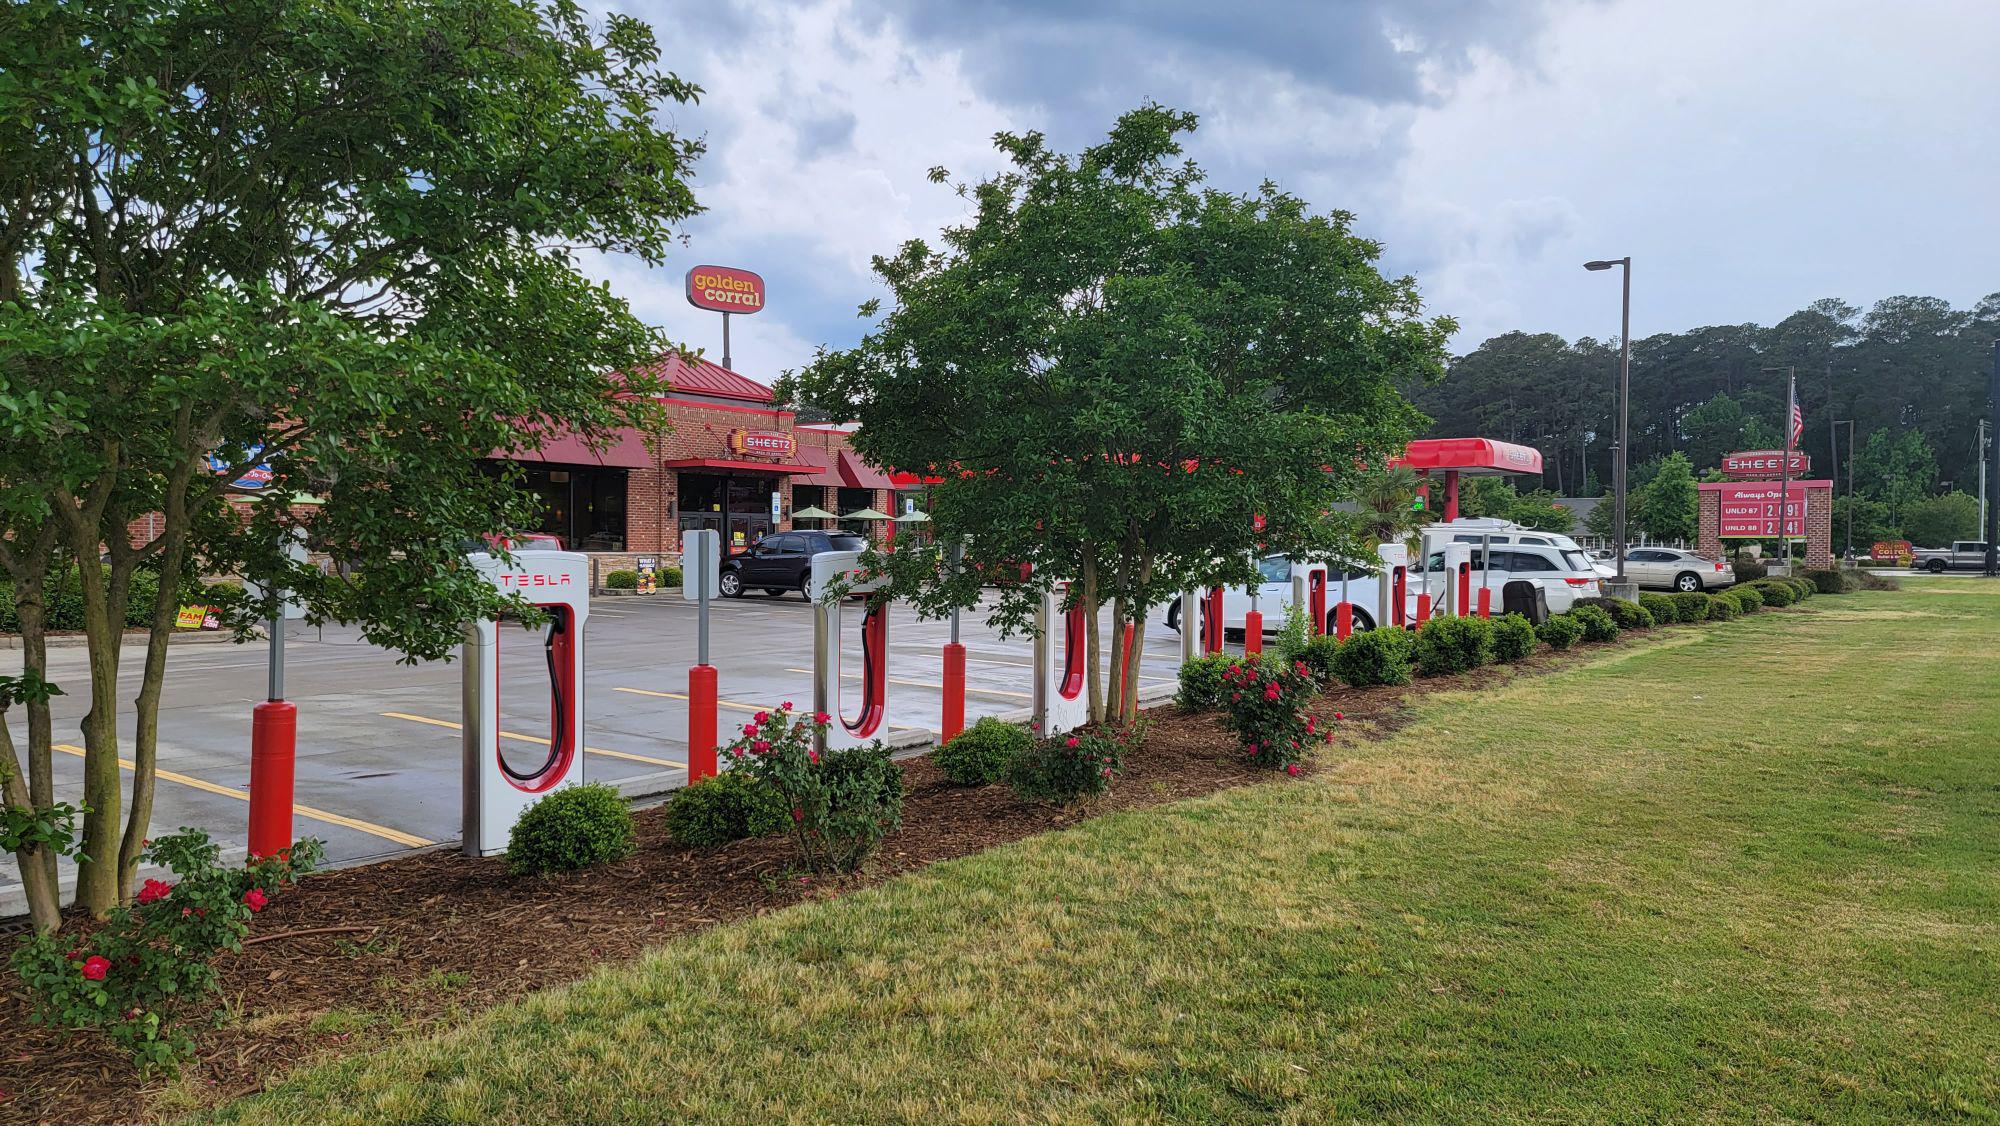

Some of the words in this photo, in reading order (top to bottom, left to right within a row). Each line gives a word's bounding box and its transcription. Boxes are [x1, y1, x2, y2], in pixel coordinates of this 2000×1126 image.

[694, 274, 754, 292] golden
[704, 289, 760, 306] corral
[747, 437, 790, 449] SHEETZ
[1734, 491, 1765, 500] Always
[500, 574, 570, 587] TESLA
[179, 612, 203, 620] FAM
